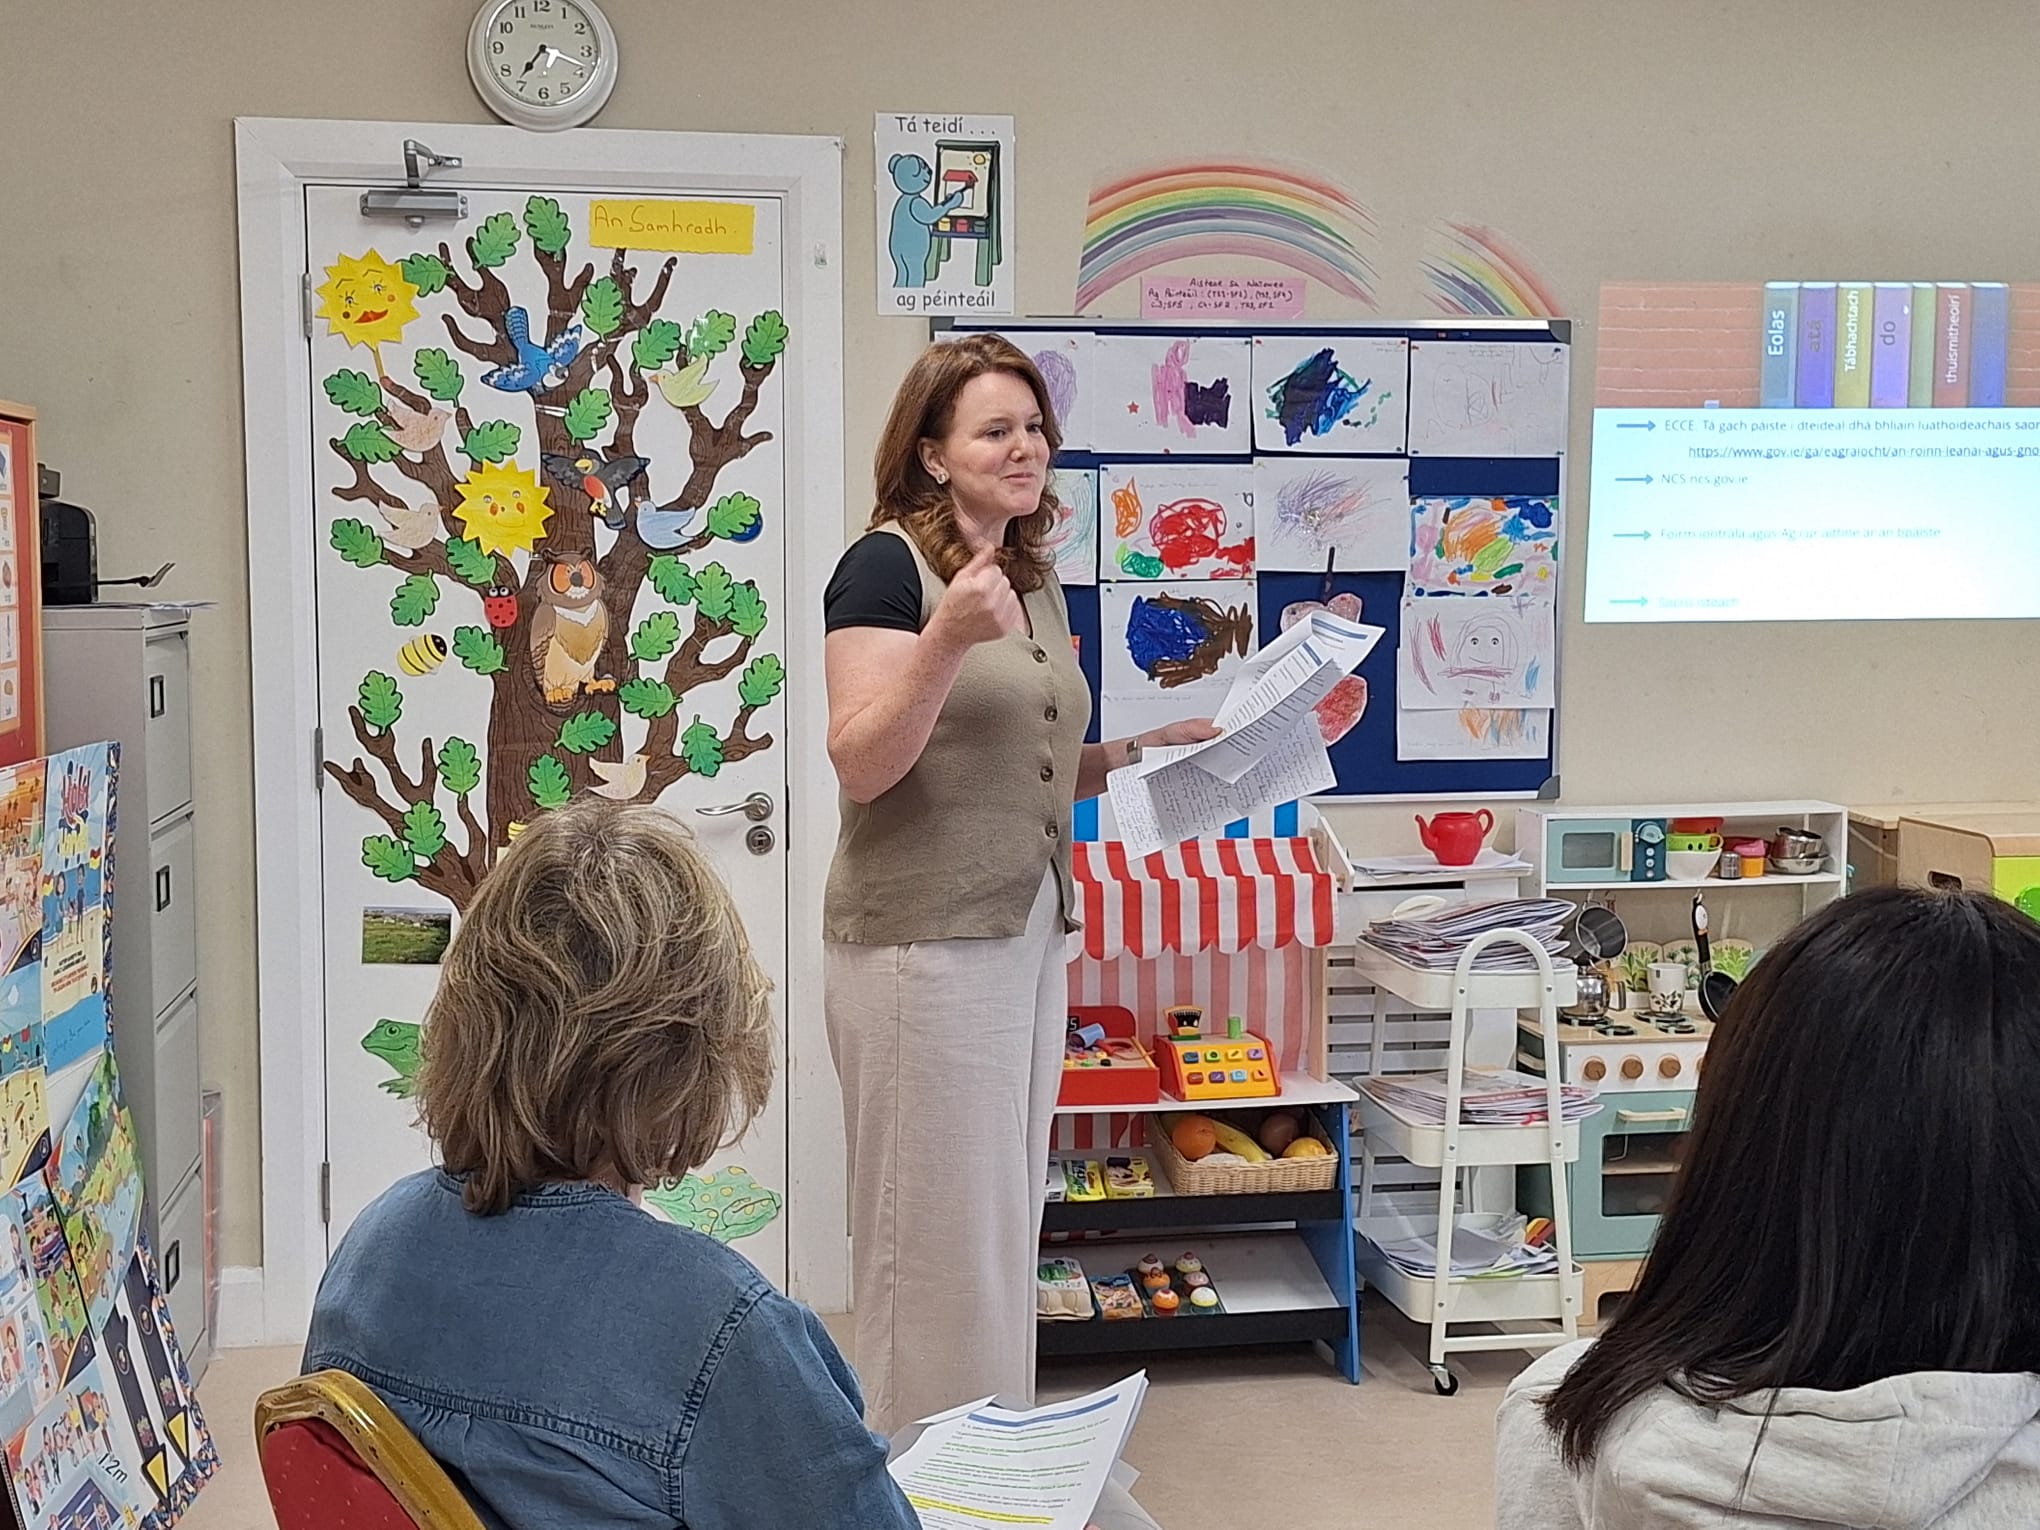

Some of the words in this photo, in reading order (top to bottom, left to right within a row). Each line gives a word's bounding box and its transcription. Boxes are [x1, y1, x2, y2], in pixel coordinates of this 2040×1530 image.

[514, 6, 526, 18] 11
[534, 0, 550, 12] 12
[562, 7, 567, 20] 1
[500, 21, 514, 34] 10
[574, 22, 586, 34] 2
[492, 41, 504, 54] 9
[581, 45, 592, 58] 3
[500, 64, 512, 77] 8
[573, 66, 584, 78] 4
[516, 80, 527, 92] 7
[560, 82, 571, 94] 5
[538, 87, 550, 100] 6
[895, 116, 917, 133] Tá
[923, 116, 963, 134] teidí
[594, 205, 623, 228] An
[897, 294, 916, 310] ag
[923, 288, 995, 310] péinteáil
[1768, 310, 1784, 356] Eolas
[1808, 319, 1822, 352] atá
[1845, 290, 1859, 372] Tábhachtach
[1880, 320, 1896, 346] do
[1946, 294, 1960, 383] thuismitheoirí
[1704, 420, 1715, 430] Tá
[1719, 420, 1747, 434] gach
[1752, 420, 1786, 432] páiste
[1798, 420, 1844, 430] dteideal
[1875, 420, 1914, 430] bhliain
[1918, 420, 2011, 430] luathoideachais
[98, 1453, 128, 1483] 1.2m
